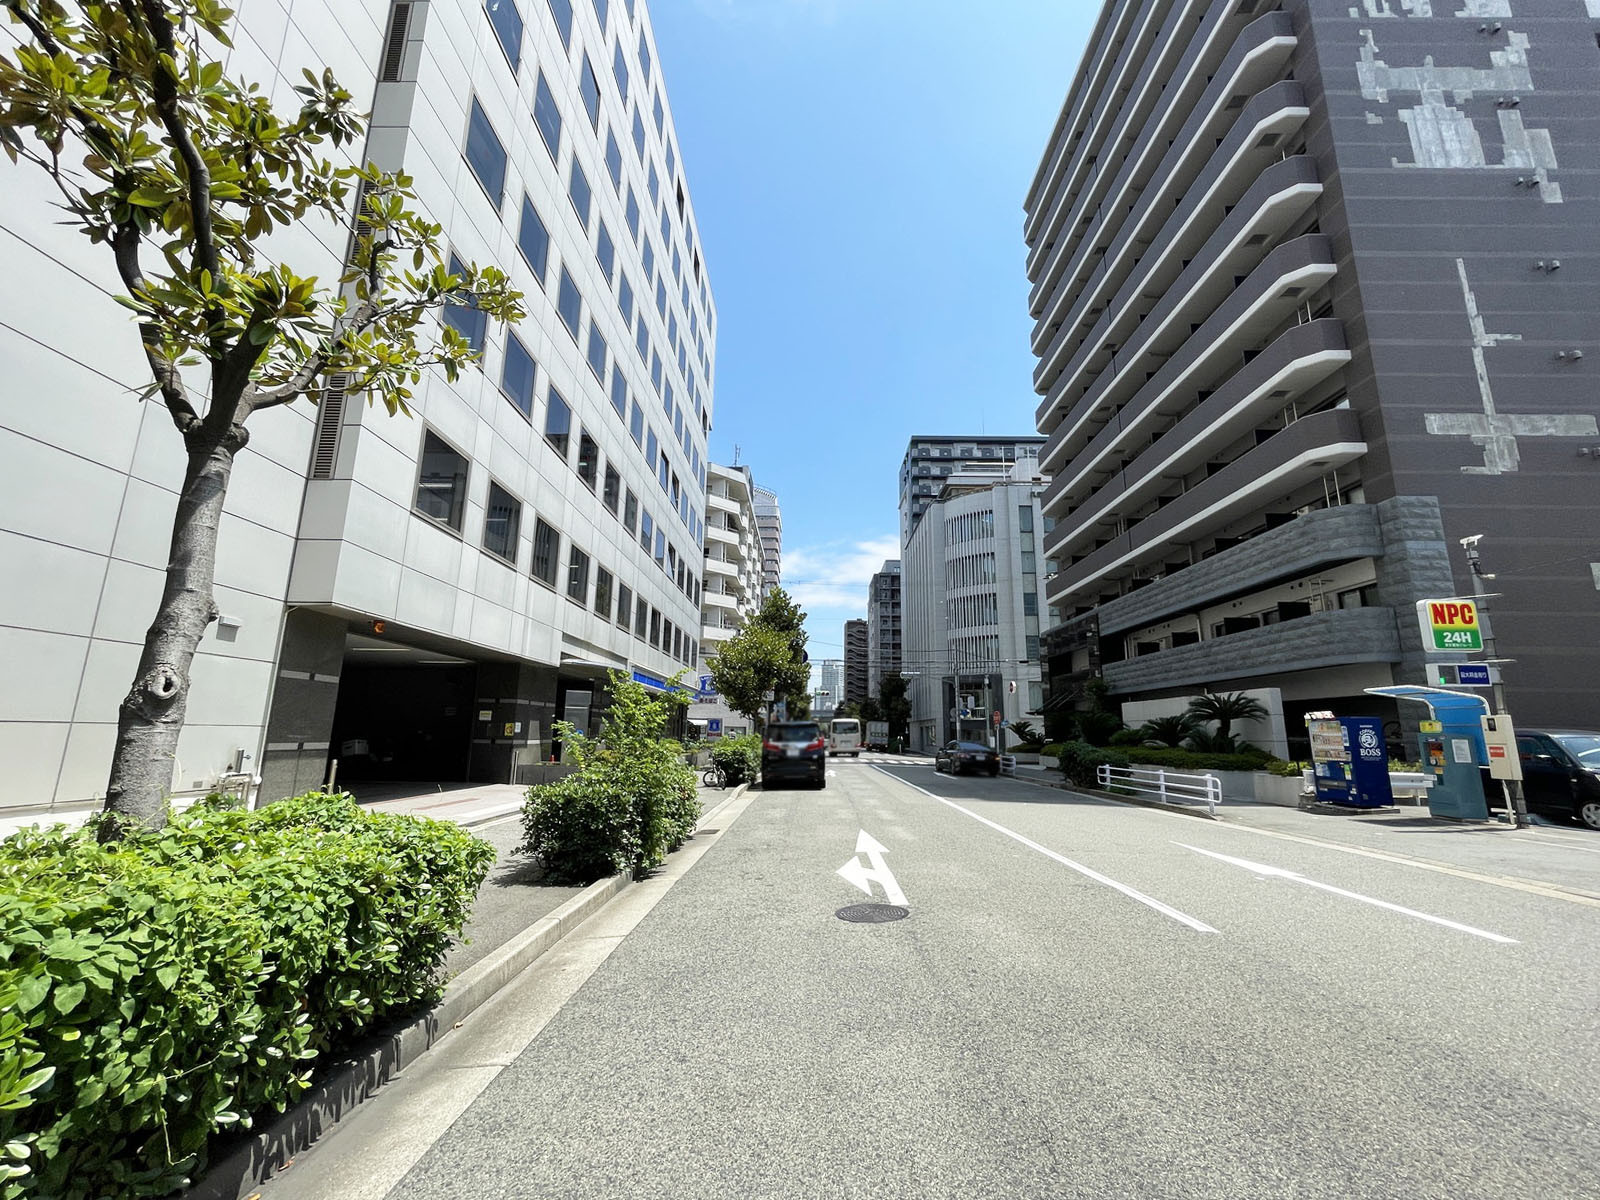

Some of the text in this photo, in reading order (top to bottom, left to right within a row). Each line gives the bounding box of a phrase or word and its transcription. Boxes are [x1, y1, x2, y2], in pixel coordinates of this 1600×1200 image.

[1431, 603, 1474, 625] NPC
[1443, 631, 1472, 643] 24H
[1360, 748, 1381, 756] BOSS
